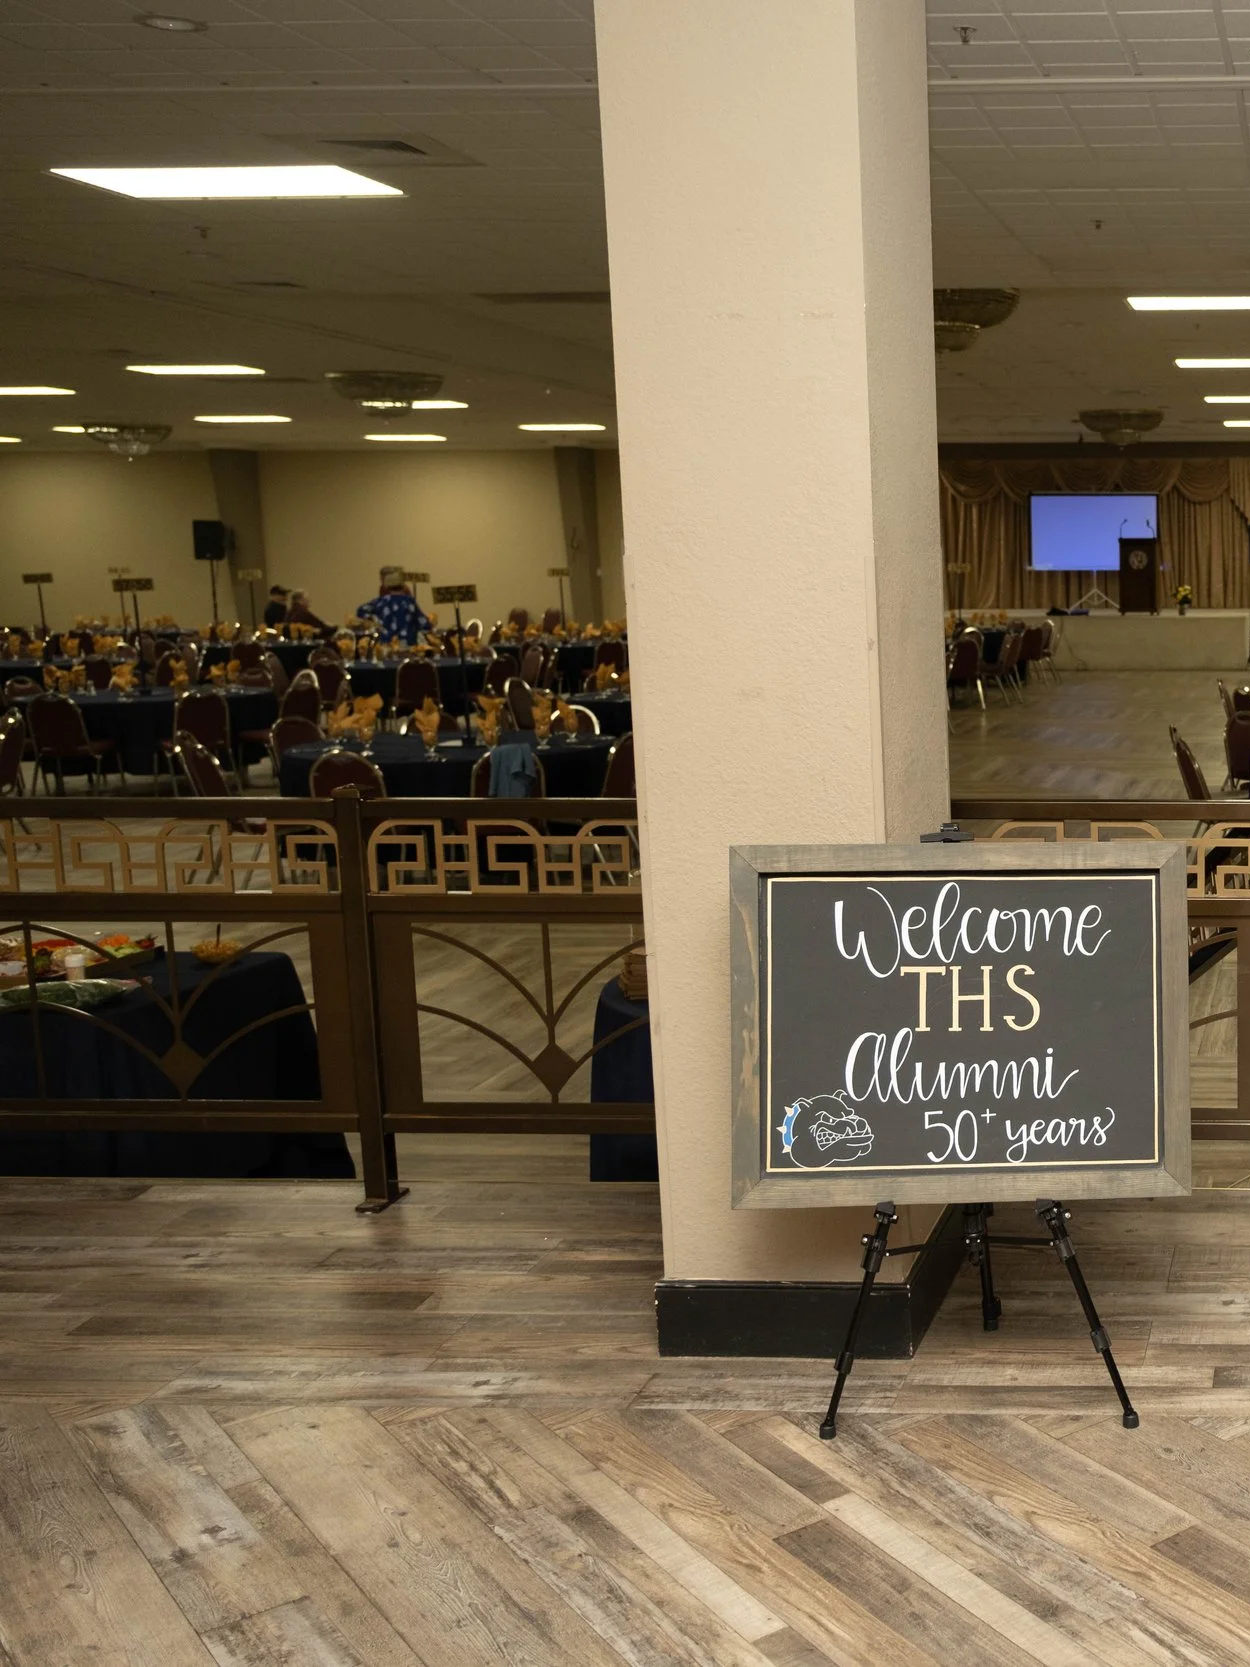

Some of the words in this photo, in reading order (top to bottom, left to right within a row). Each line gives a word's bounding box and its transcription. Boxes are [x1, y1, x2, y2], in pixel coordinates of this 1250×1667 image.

[834, 882, 1112, 978] Welcome
[900, 964, 1041, 1032] THS
[844, 1027, 1079, 1104] Alumni
[1005, 1106, 1116, 1163] years
